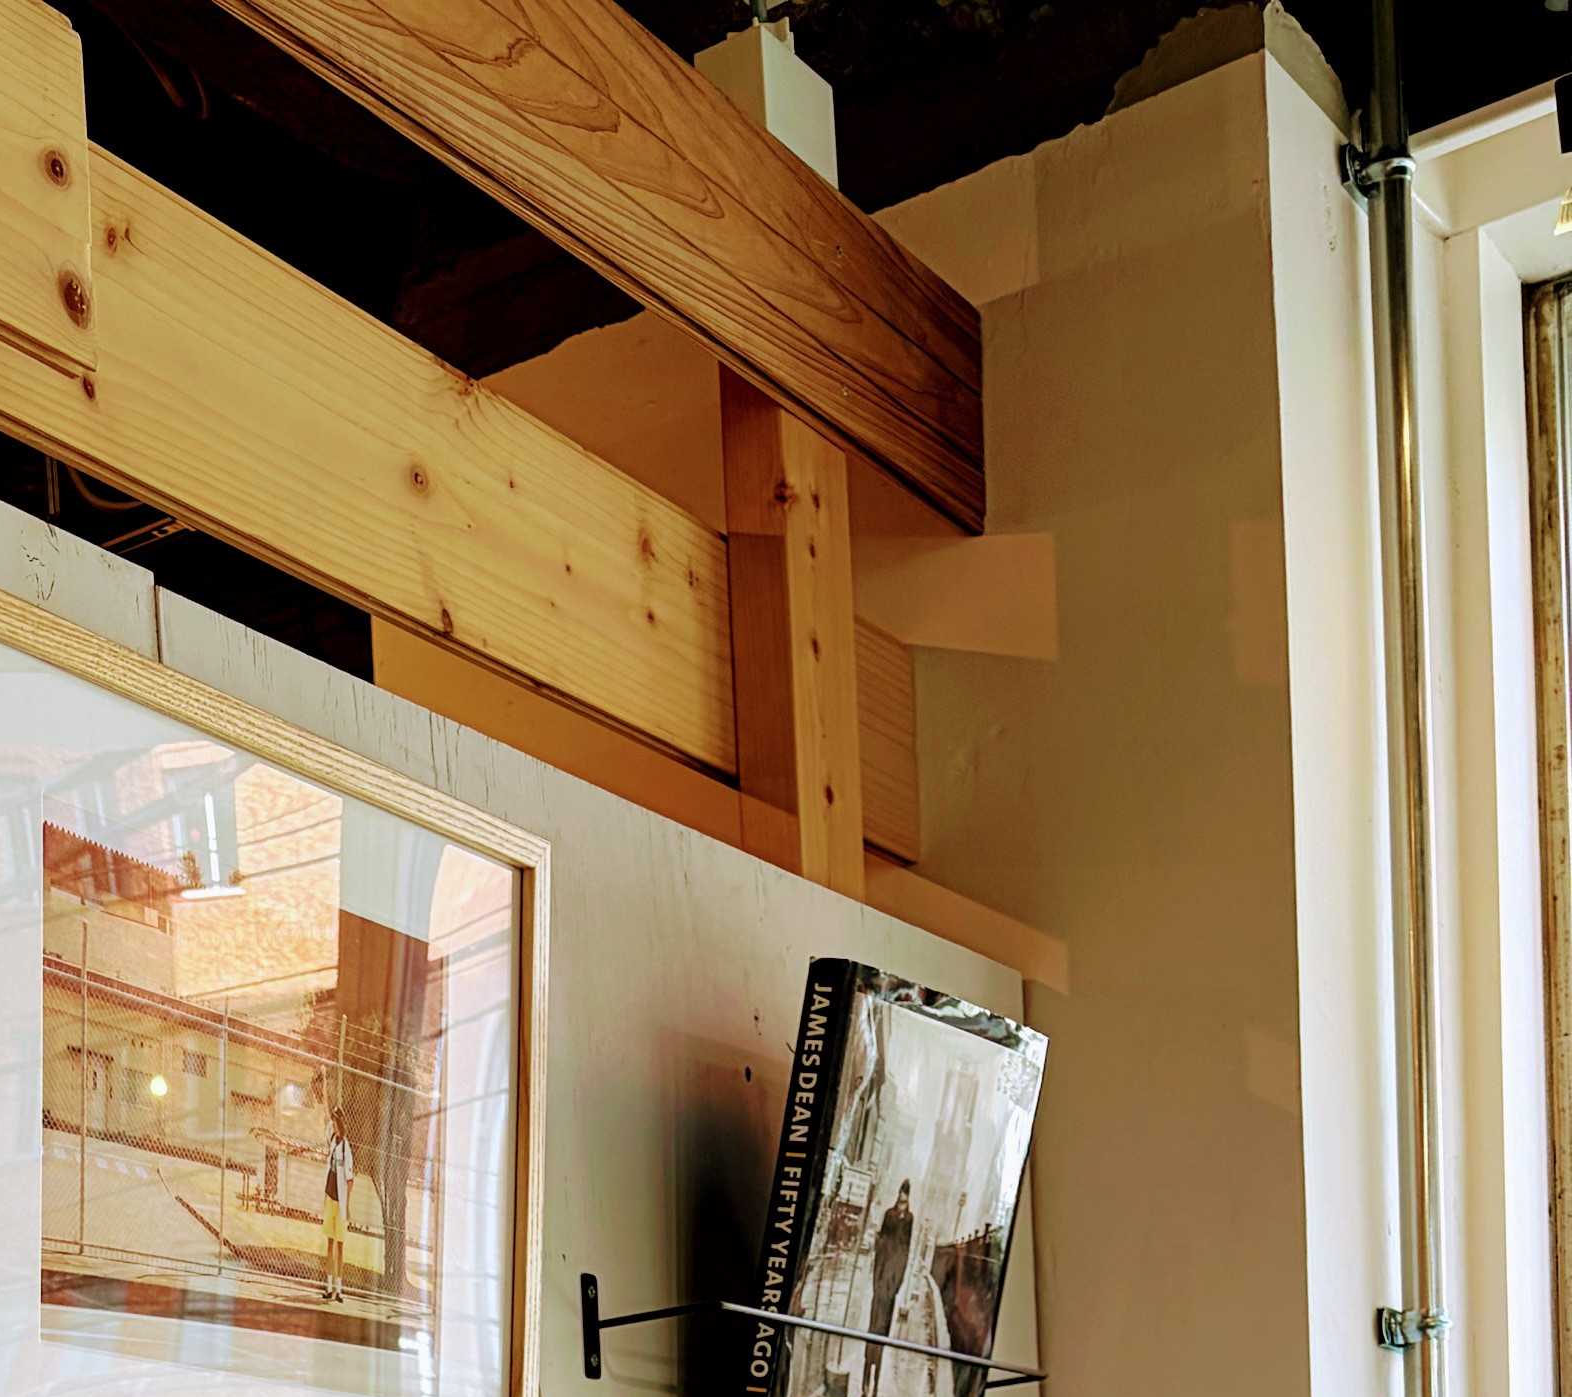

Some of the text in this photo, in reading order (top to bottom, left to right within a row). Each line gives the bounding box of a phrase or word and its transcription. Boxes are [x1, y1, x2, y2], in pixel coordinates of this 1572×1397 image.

[801, 982, 833, 1067] JAMES
[788, 1073, 819, 1142] DEAN
[775, 1167, 803, 1236] FIFTY
[760, 1240, 791, 1316] YEARS
[750, 1322, 775, 1378] AGO
